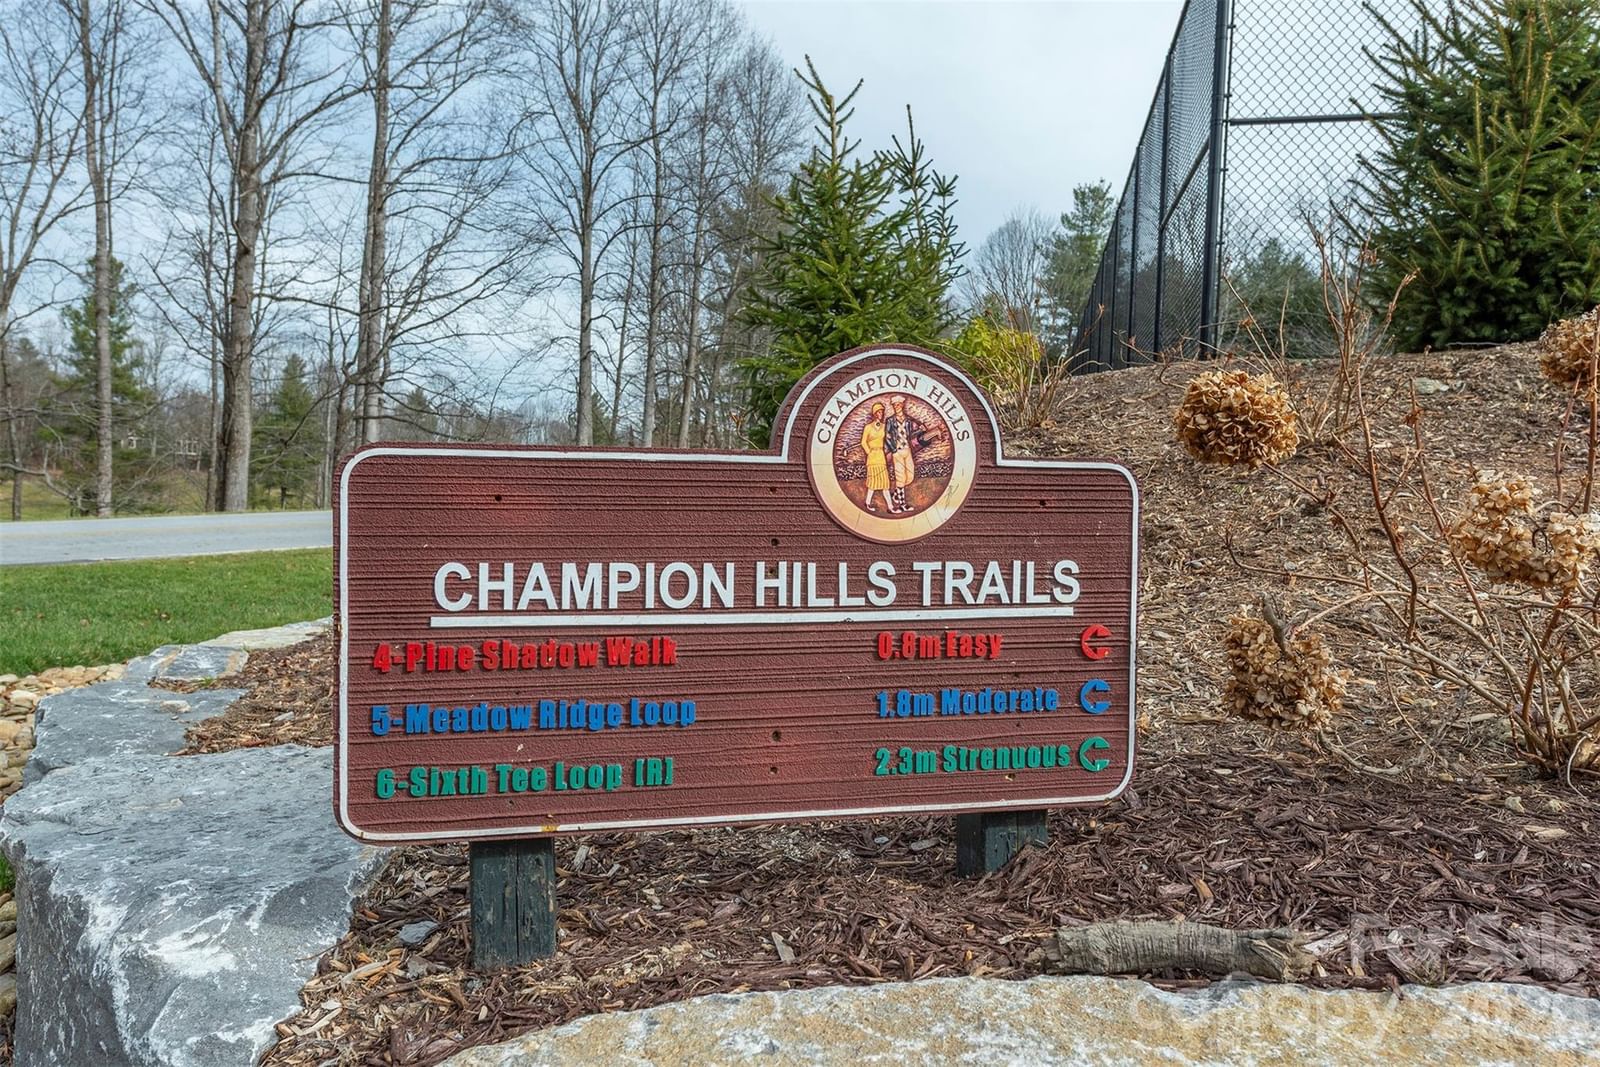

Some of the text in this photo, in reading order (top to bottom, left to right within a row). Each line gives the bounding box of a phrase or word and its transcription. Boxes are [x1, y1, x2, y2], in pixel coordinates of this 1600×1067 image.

[817, 373, 970, 444] CHAMPION HILLS
[434, 560, 1080, 612] CHAMPION HILLS TRAILS
[373, 636, 678, 673] 4-Pine Shadow Walk
[878, 630, 1003, 660] 0.8m Easy
[372, 698, 697, 736] 5-Meadow Ridge Loop
[876, 688, 1059, 718] 1.8m Moderate
[875, 745, 1072, 776] 2.3m Strenuous
[376, 766, 489, 799] 6-Sixth
[496, 764, 548, 793] Tee
[555, 761, 623, 791] Loop
